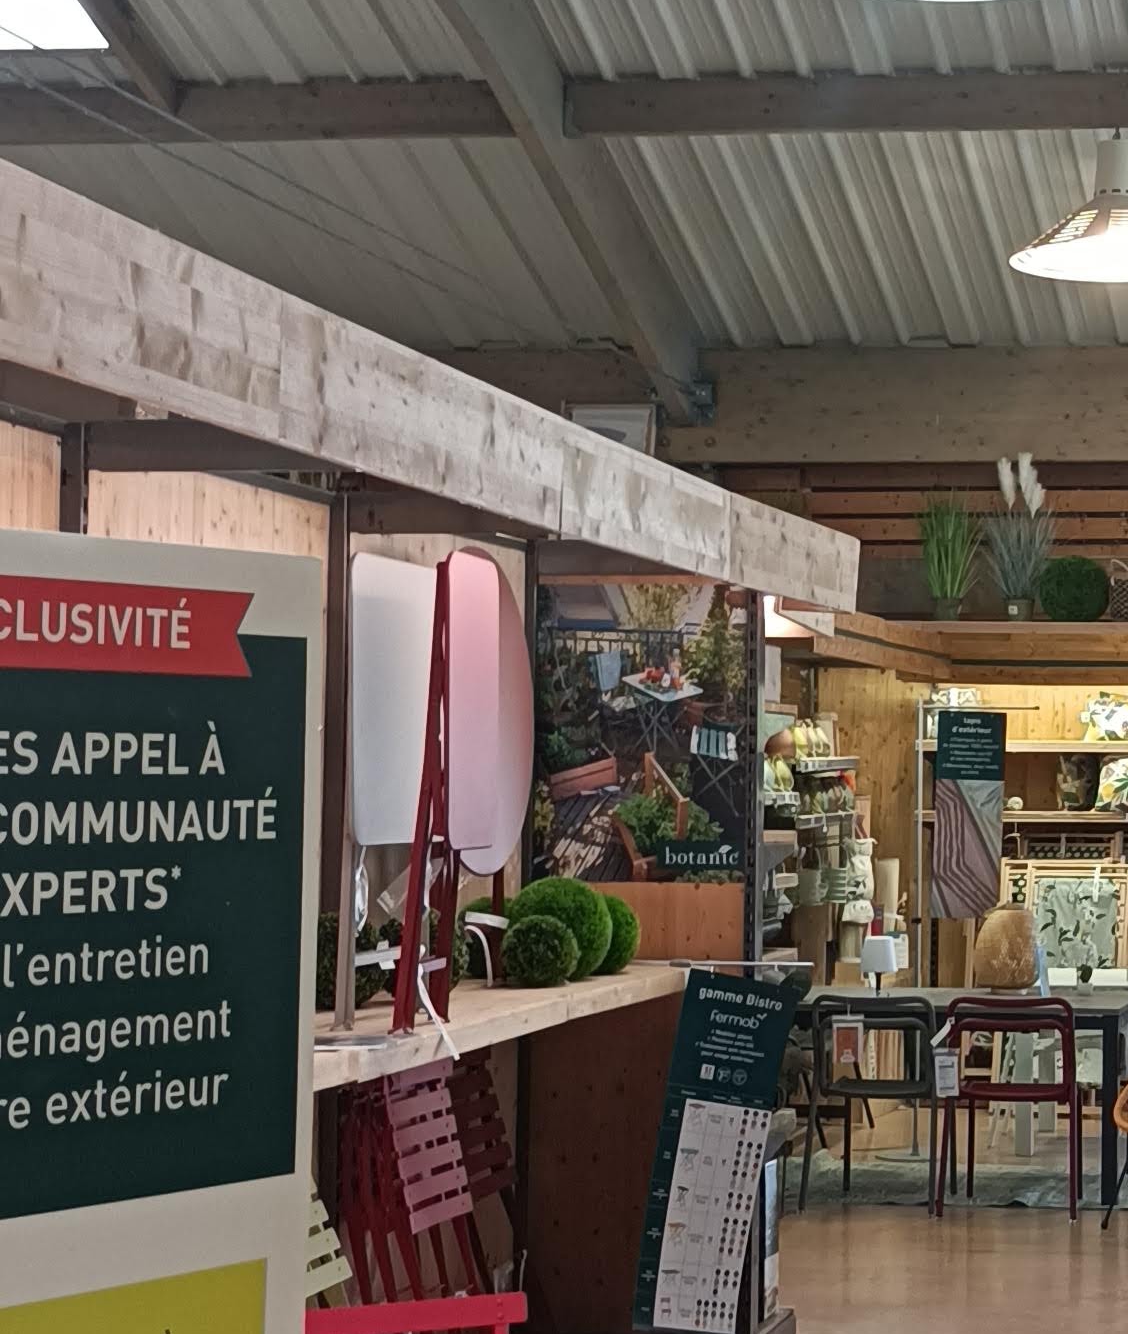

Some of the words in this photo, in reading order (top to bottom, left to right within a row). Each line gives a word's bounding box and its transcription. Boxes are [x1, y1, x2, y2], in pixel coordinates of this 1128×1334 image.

[51, 731, 189, 776] APPEL
[199, 721, 226, 776] À
[665, 845, 740, 865] botanic
[3, 935, 209, 988] l'entretien
[698, 987, 744, 1004] gamme
[0, 999, 231, 1063] énagement
[46, 1070, 228, 1125] extérieur
